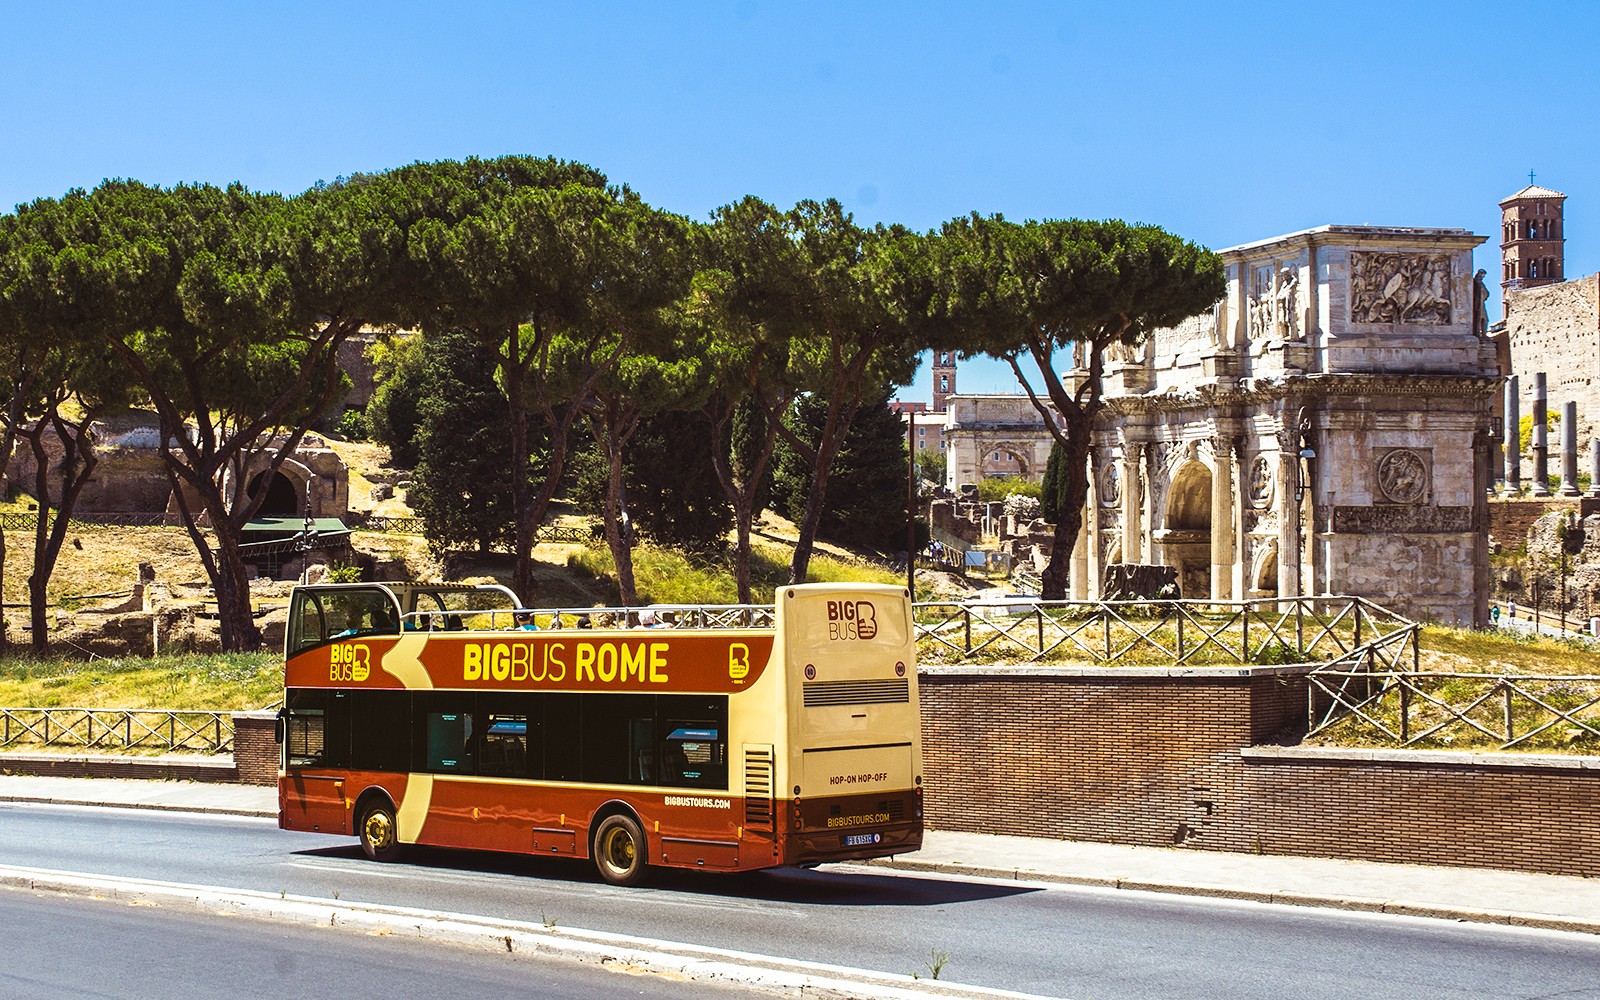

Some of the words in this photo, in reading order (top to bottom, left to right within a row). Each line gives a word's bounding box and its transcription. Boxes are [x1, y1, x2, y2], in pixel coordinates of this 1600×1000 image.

[827, 600, 855, 621] BIG
[829, 622, 857, 640] BUS
[330, 643, 353, 663] BIG
[575, 642, 670, 683] ROME
[330, 663, 352, 681] BUS
[829, 774, 857, 785] HOP-ON
[858, 772, 888, 783] HOP-OFF
[664, 796, 731, 809] BIGBUSTOURS.COM
[827, 813, 890, 828] BIGBUSTOURS.COM
